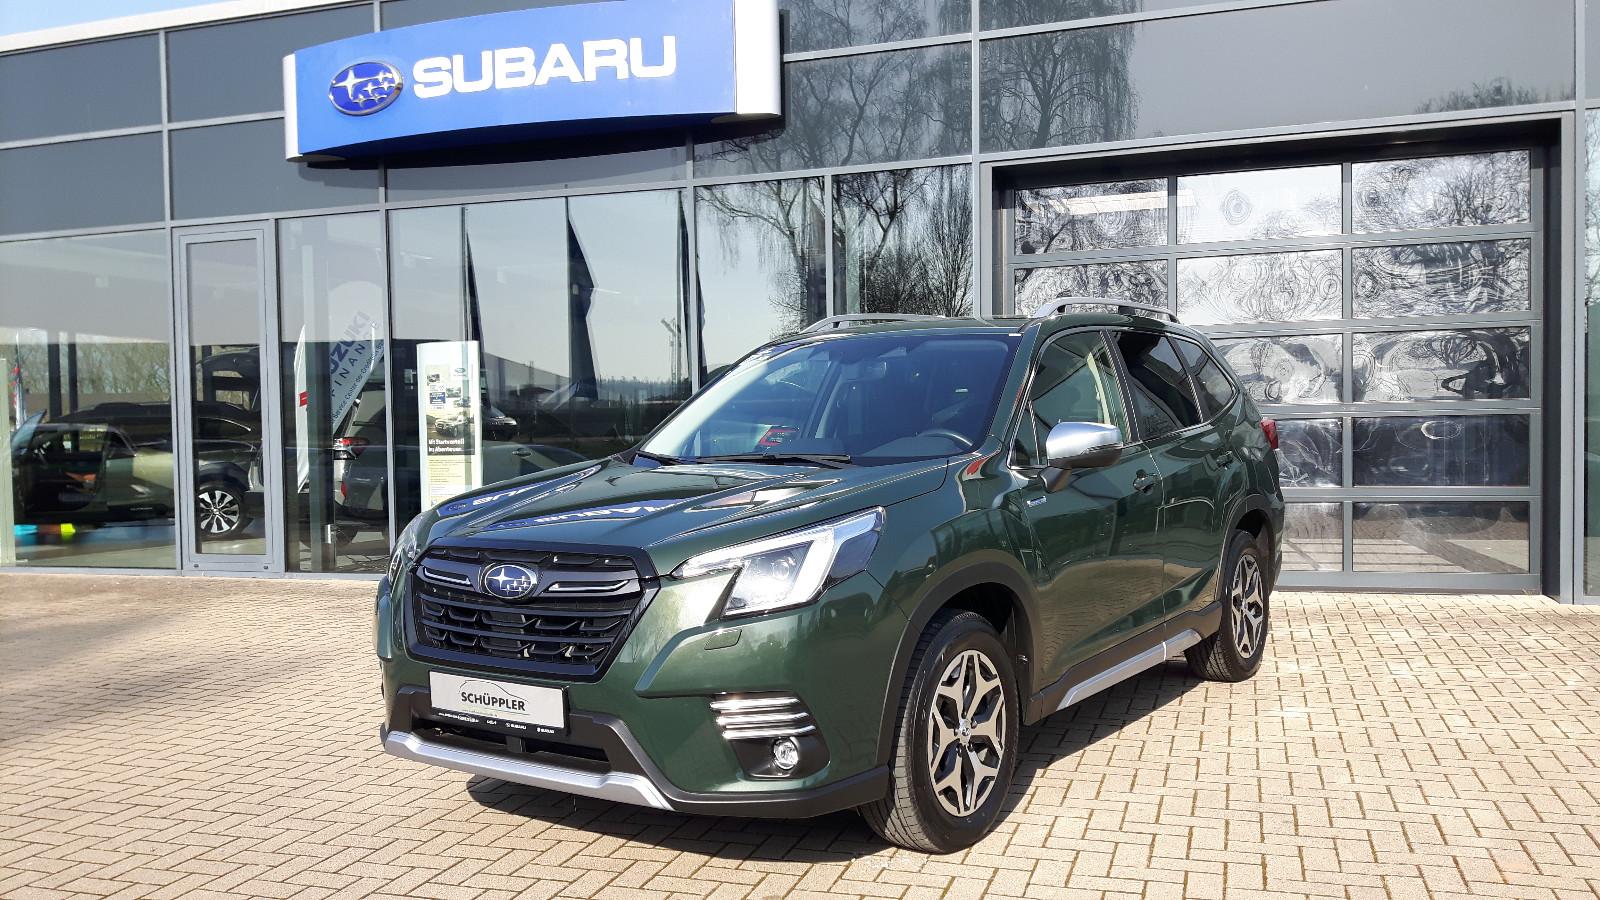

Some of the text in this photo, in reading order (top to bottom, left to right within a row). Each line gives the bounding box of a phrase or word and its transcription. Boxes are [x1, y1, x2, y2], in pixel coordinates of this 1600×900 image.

[413, 35, 677, 99] SUBARU
[330, 311, 371, 374] UZUKI
[461, 692, 526, 711] SCHÜPPLER
